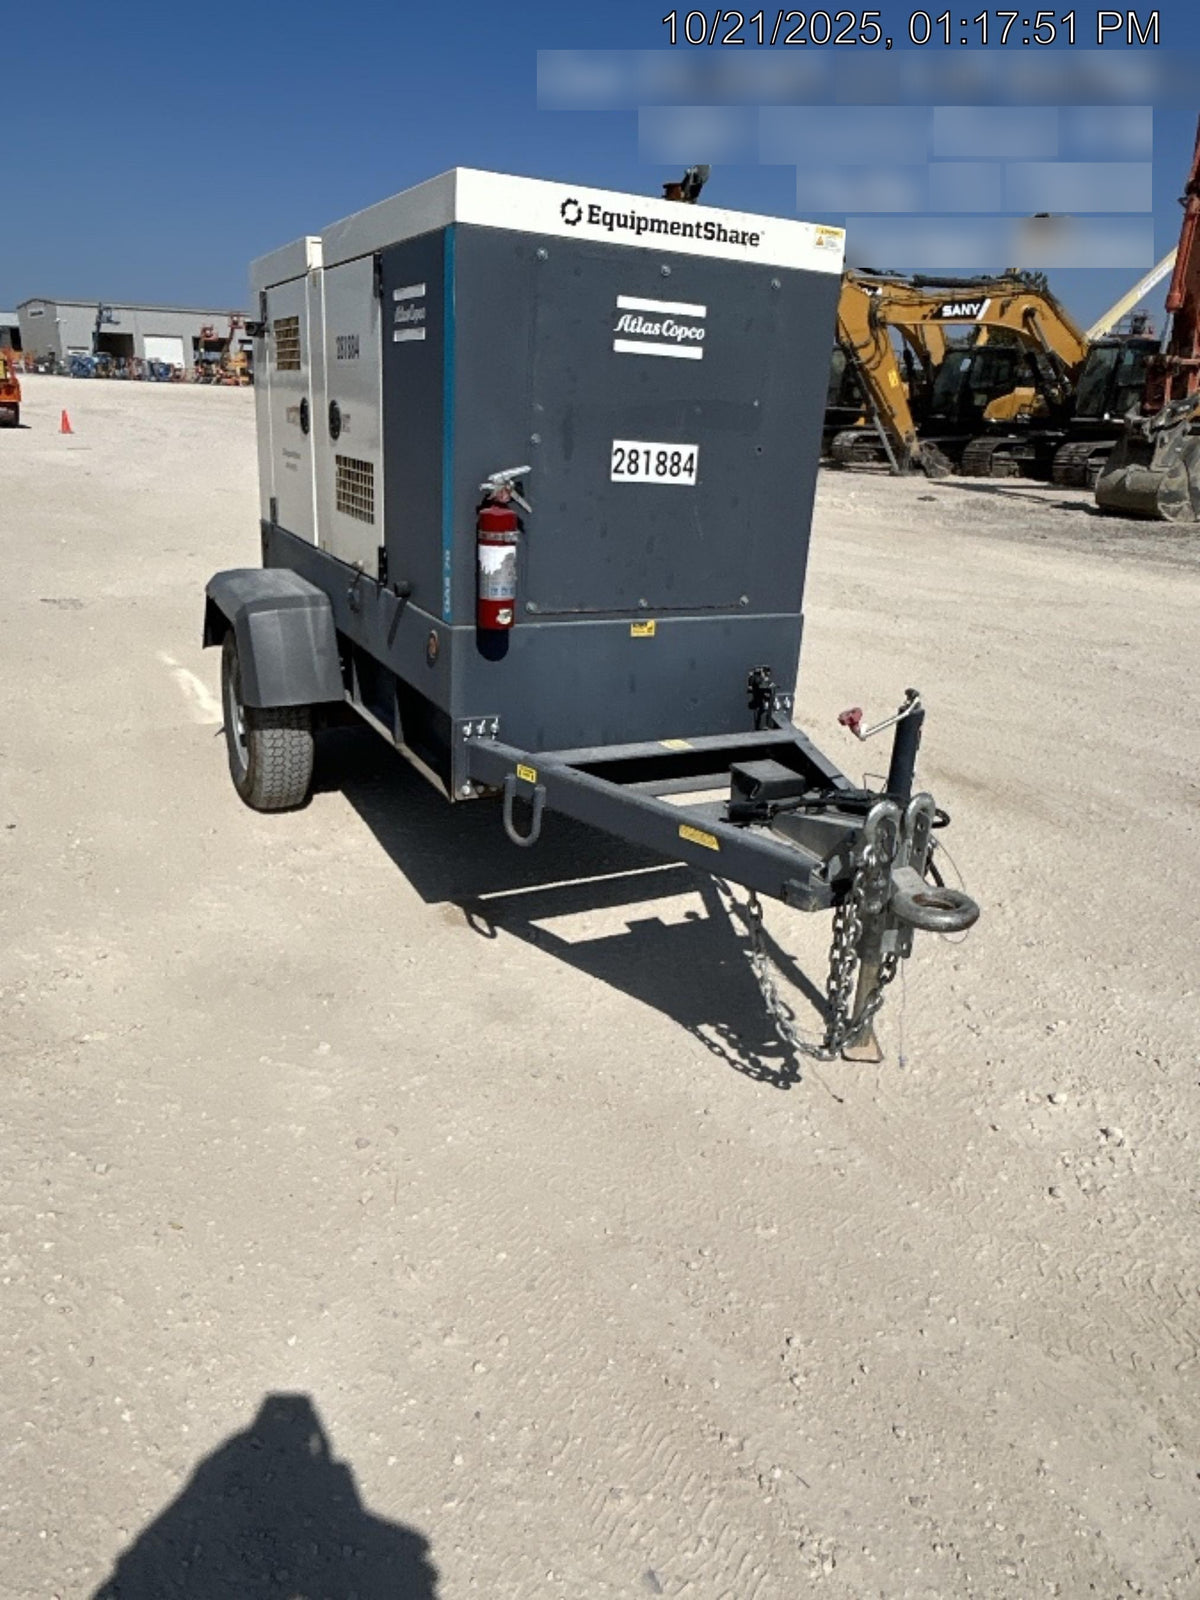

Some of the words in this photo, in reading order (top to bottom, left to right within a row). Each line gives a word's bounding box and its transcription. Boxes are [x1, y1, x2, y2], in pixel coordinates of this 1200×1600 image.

[587, 204, 761, 247] EquipmentShare
[942, 303, 981, 317] SANY
[612, 447, 695, 478] 281884
